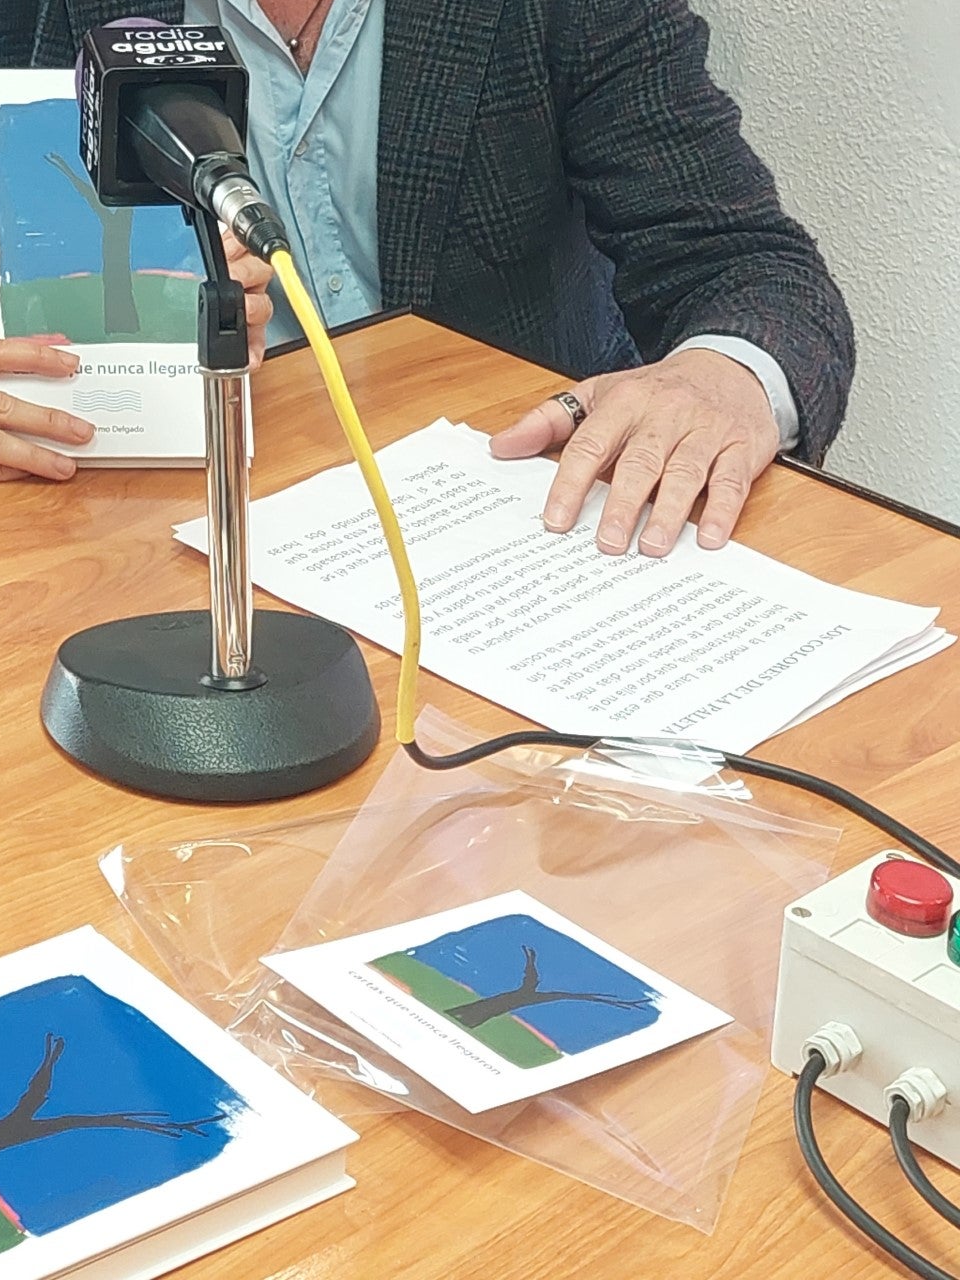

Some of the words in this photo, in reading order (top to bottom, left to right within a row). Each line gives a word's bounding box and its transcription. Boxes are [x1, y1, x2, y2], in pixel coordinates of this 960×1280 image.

[124, 28, 204, 41] radio
[111, 39, 227, 55] aguilar
[74, 363, 93, 376] ue
[97, 363, 145, 376] nunca
[149, 360, 201, 378] llegaro
[111, 424, 145, 434] Delgado
[609, 573, 629, 584] tu
[679, 571, 705, 585] más
[706, 579, 729, 589] ha
[565, 579, 615, 604] decisión.
[626, 581, 684, 613] explicación
[676, 585, 715, 606] hecho
[712, 586, 748, 606] hasta
[550, 601, 573, 615] No
[693, 602, 718, 616] que
[721, 595, 766, 622] importa
[753, 603, 789, 620] bien,
[529, 611, 555, 626] voy
[594, 619, 614, 629] la
[605, 609, 631, 624] que
[631, 603, 680, 630] dejarnos
[668, 619, 688, 630] te
[680, 612, 698, 623] se
[743, 617, 762, 629] ya
[783, 610, 809, 624] Me
[569, 625, 599, 642] nota
[643, 624, 673, 642] pase
[699, 618, 725, 633] que
[721, 625, 749, 641] más
[760, 622, 787, 639] dice
[818, 623, 853, 641] LOS
[482, 625, 526, 649] suplicar
[605, 626, 640, 642] hace
[686, 629, 705, 641] te
[747, 636, 767, 646] la
[466, 645, 487, 656] tu
[543, 646, 563, 655] la
[555, 638, 575, 649] de
[591, 637, 611, 650] ya
[625, 638, 648, 652] esa
[646, 637, 689, 660] quedes
[672, 636, 729, 664] tranquila,
[505, 650, 548, 672] cocina.
[569, 646, 598, 661] tres
[581, 648, 630, 674] angustia
[712, 643, 750, 666] madre
[757, 638, 825, 682] COLORES
[619, 657, 651, 675] unos
[653, 661, 679, 676] que
[694, 663, 715, 675] de
[525, 670, 548, 684] sin
[559, 670, 586, 686] que
[635, 671, 658, 687] por
[663, 672, 700, 692] Laura
[545, 683, 566, 694] te
[564, 685, 598, 702] más,
[614, 682, 639, 698] ella
[734, 678, 766, 696] DE
[599, 694, 620, 707] no
[639, 689, 665, 705] que
[714, 691, 744, 706] LA
[587, 703, 608, 713] le
[608, 702, 641, 722] estás
[659, 702, 723, 736] PALETA
[348, 970, 384, 996] cartas
[385, 995, 410, 1012] que
[409, 1012, 448, 1039] nunca
[449, 1038, 501, 1076] llegaron
